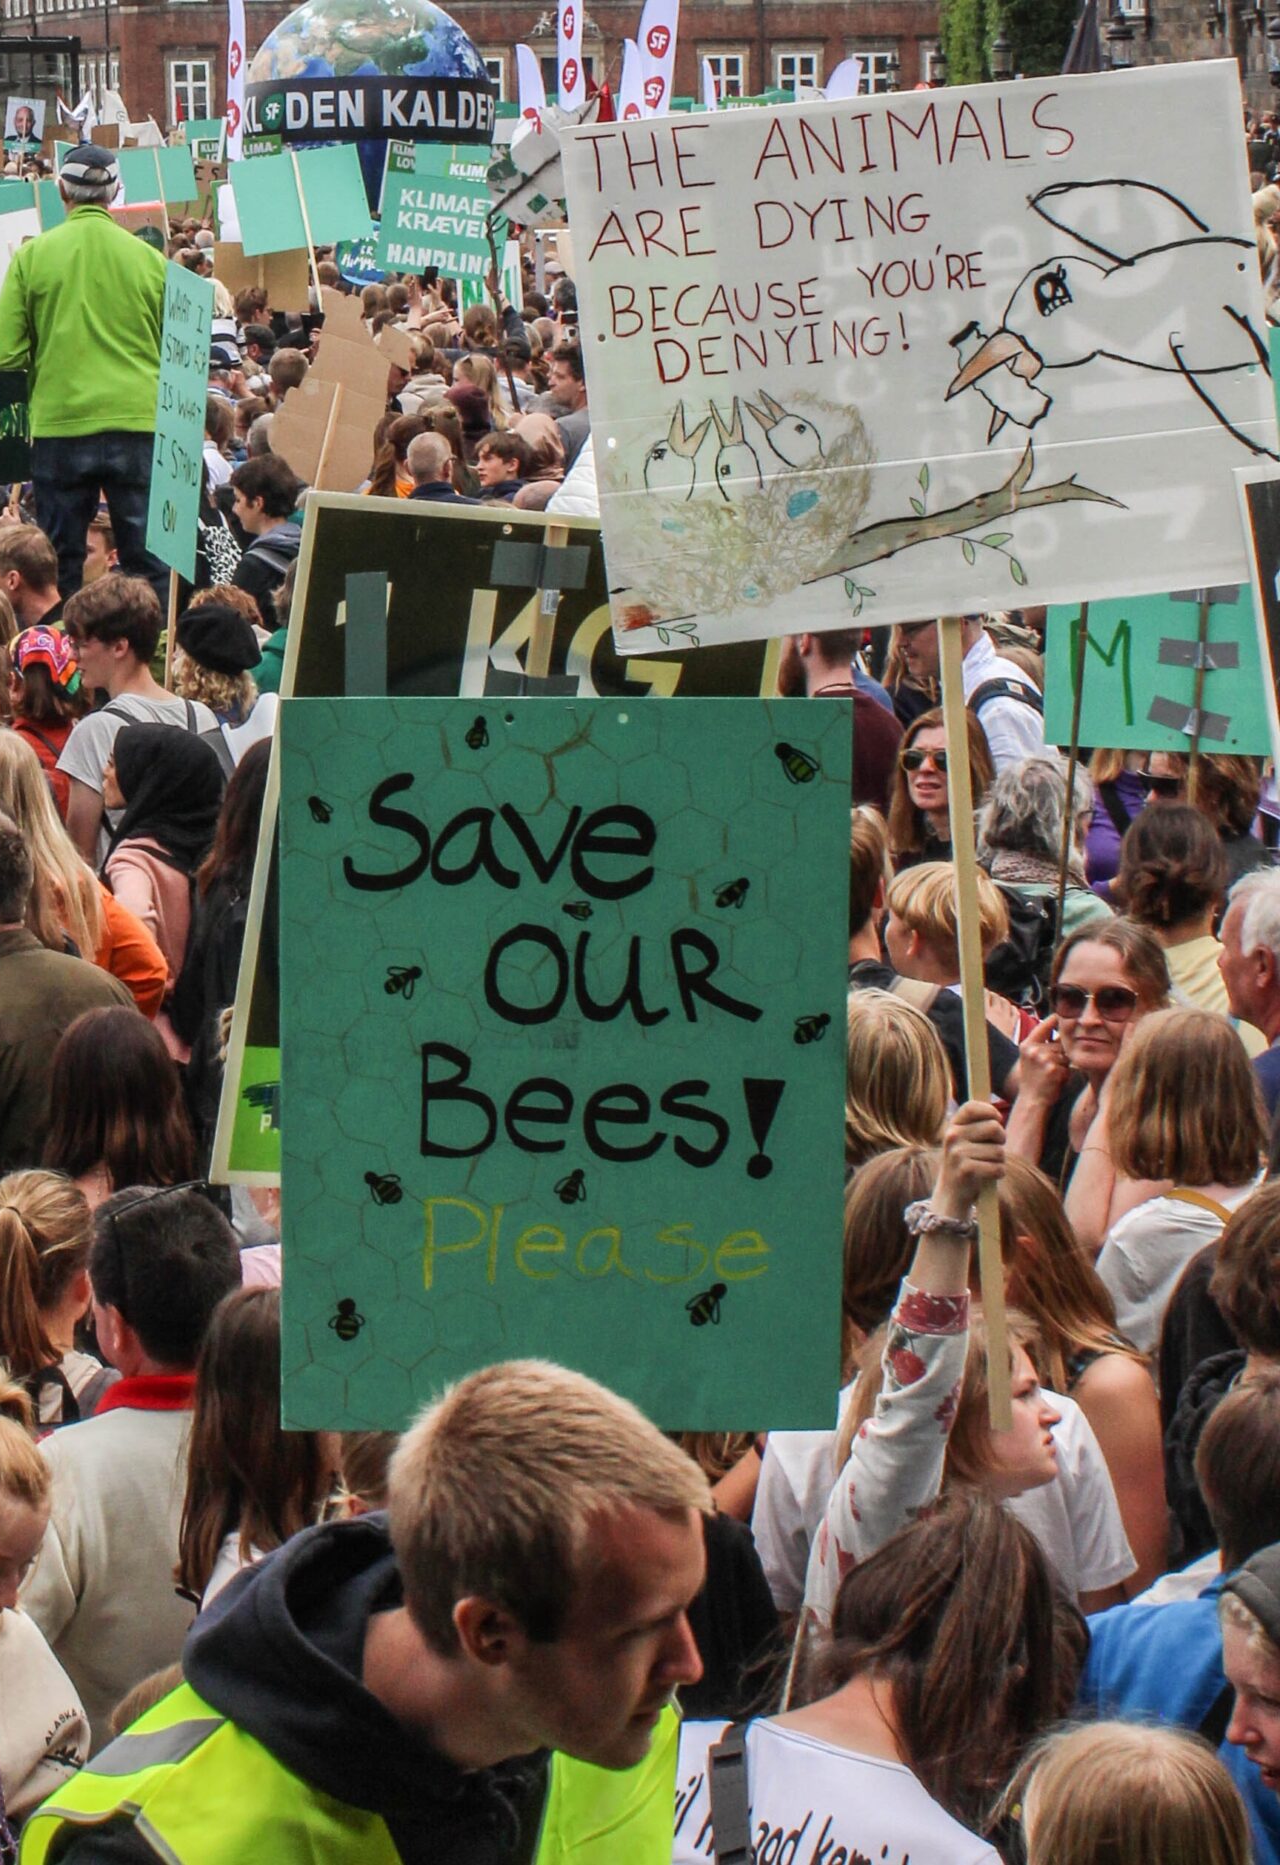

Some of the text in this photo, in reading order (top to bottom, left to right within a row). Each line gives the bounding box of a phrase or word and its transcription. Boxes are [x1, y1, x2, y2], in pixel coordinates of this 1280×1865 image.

[649, 31, 668, 49] SF
[382, 89, 494, 132] KALDER
[646, 83, 662, 100] SF
[574, 92, 1075, 193] THE ANIMALS
[588, 193, 931, 262] ARE DYING
[169, 288, 205, 335] WHAT I
[608, 244, 987, 339] BECAUSE YOU'RE
[165, 333, 191, 369] STAND
[655, 312, 910, 385] DENYING!
[161, 381, 202, 426] IS WHAT
[156, 432, 198, 487] I STAND
[342, 772, 657, 901] Save
[420, 1042, 787, 1181] Bees!
[422, 1195, 772, 1292] Please
[44, 1707, 78, 1747] ALASKA
